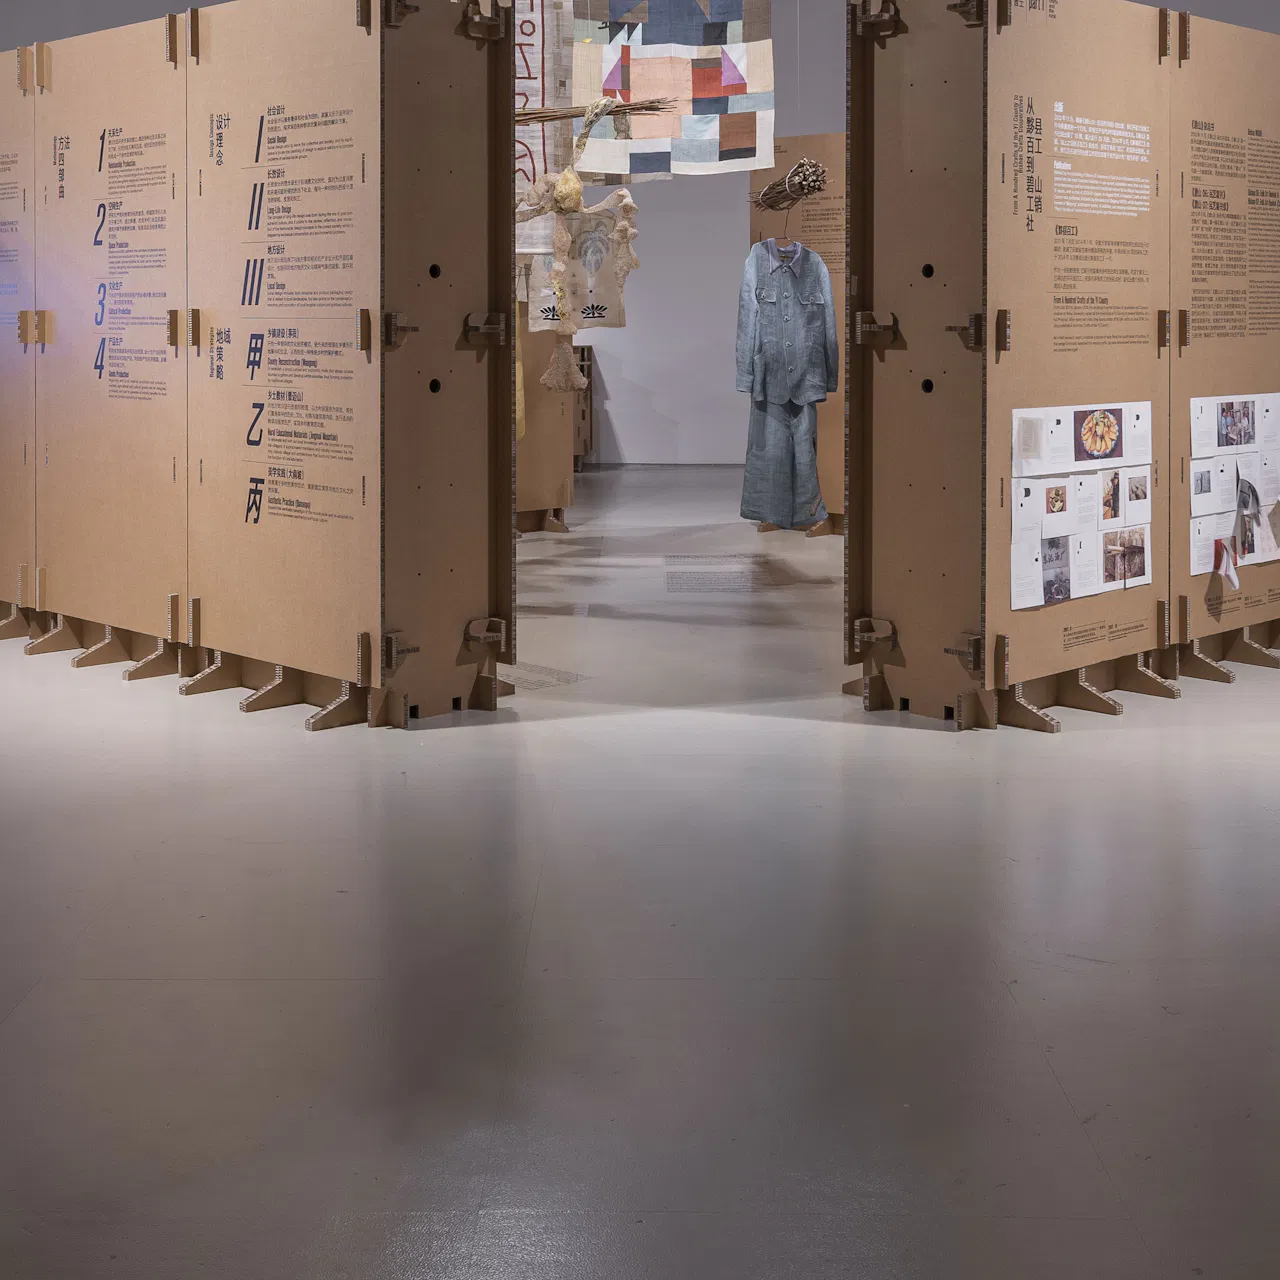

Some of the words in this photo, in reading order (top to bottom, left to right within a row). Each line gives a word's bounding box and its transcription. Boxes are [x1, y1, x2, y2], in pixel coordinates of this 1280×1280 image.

[98, 128, 107, 172] 1
[93, 202, 107, 247] 2
[94, 282, 107, 326] 3
[93, 337, 106, 380] 4
[246, 333, 265, 381] 甲
[246, 402, 265, 447] 乙
[245, 477, 265, 524] 丙
